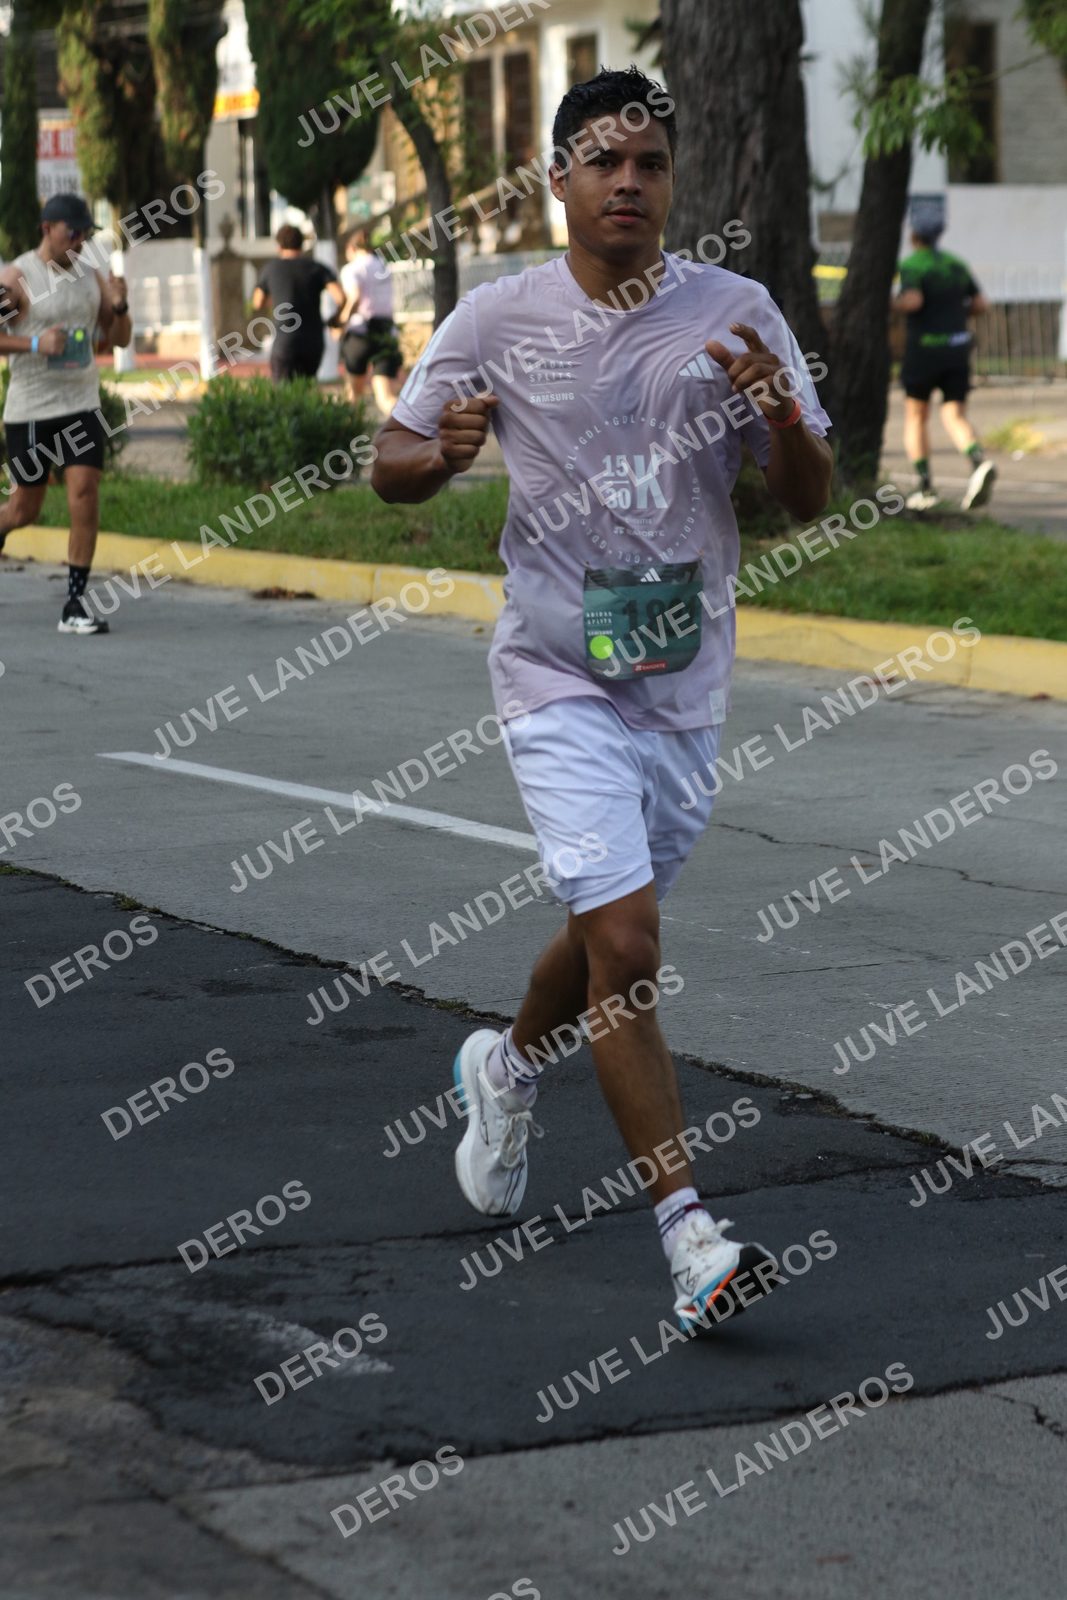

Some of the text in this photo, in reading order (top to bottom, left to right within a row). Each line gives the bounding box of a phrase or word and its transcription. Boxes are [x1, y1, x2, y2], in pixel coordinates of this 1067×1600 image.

[528, 359, 572, 370] IDAS
[529, 371, 572, 383] SPLITS
[529, 391, 575, 404] SAMSUNG
[578, 426, 601, 446] GDL
[612, 415, 636, 426] GDL
[601, 454, 627, 477] 15
[633, 454, 670, 509] K
